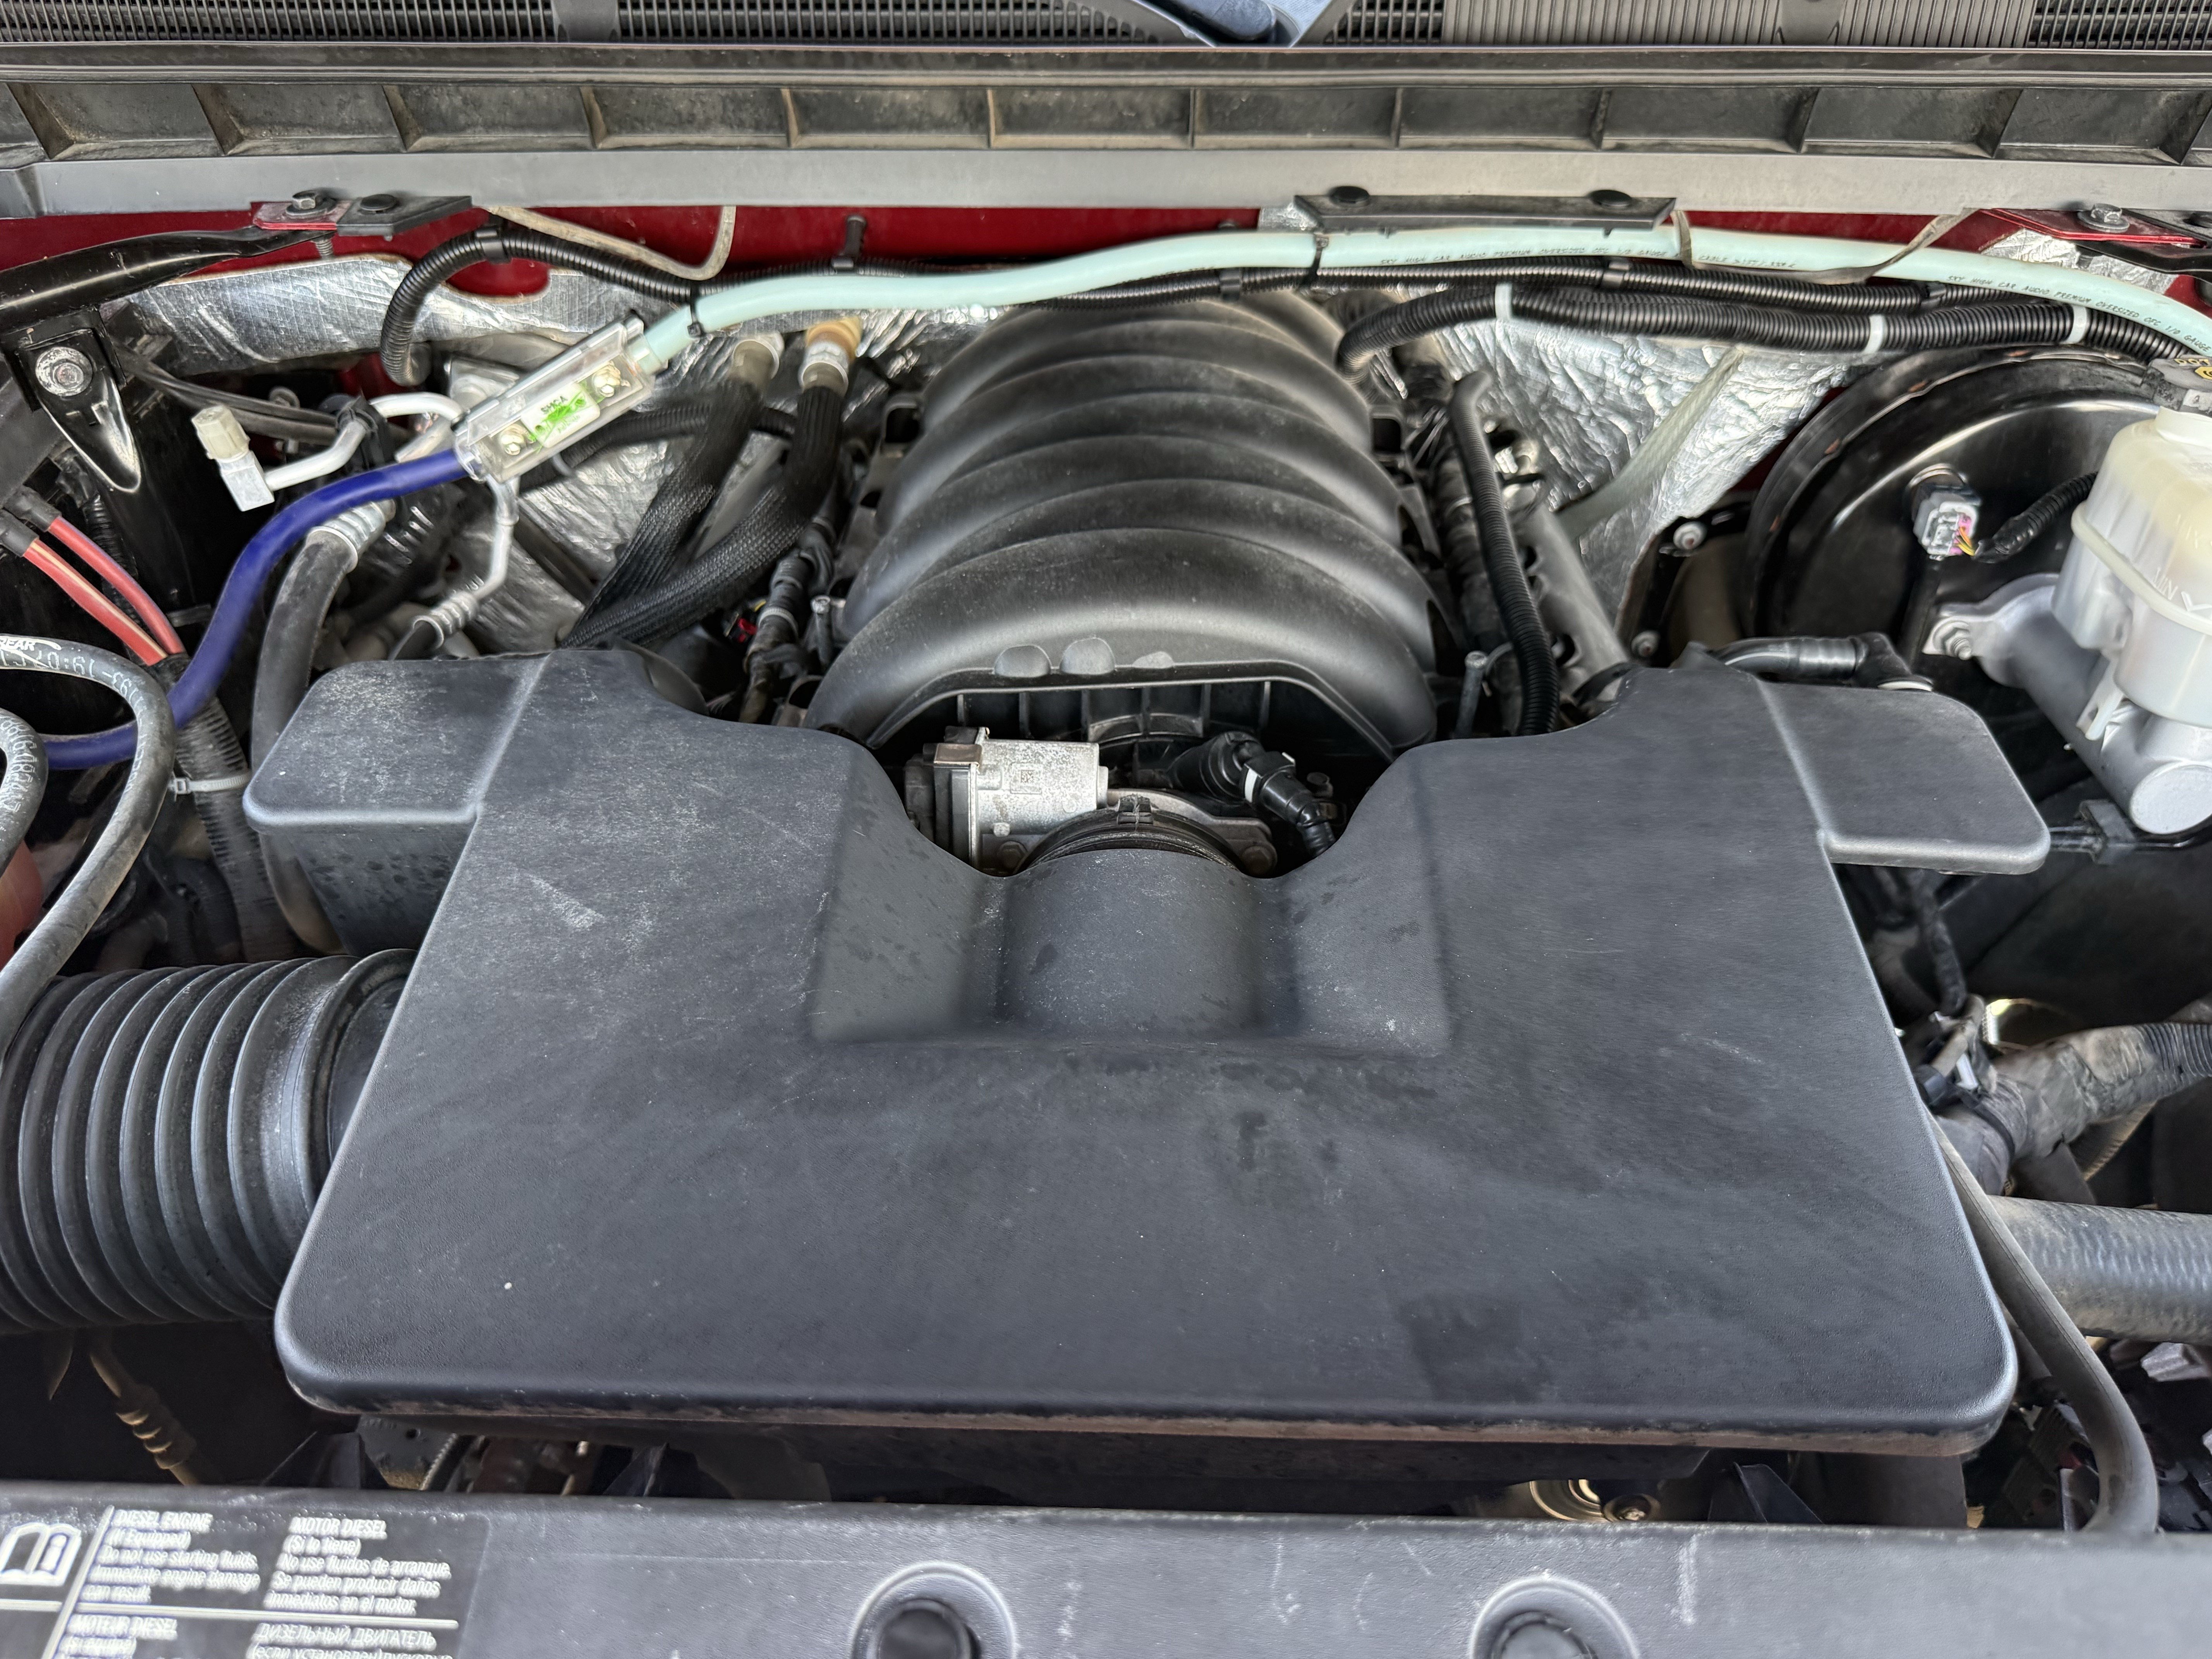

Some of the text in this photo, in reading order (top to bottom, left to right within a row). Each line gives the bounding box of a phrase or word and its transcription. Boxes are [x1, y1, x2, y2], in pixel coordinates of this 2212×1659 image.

[2021, 285, 2050, 294] AUDIO
[2054, 291, 2092, 304] PREMIUM
[2095, 301, 2140, 318] OVERSIZED
[2164, 325, 2181, 335] 1/0
[2183, 334, 2212, 352] GAUGE
[112, 1509, 213, 1532] DIESEL ENGINE
[289, 1517, 386, 1539] MOTOR DIESEL
[125, 1529, 191, 1549] Equipped)
[283, 1535, 305, 1554] (Si
[320, 1536, 361, 1556] tiene)
[96, 1546, 118, 1564] Do
[118, 1549, 143, 1565] not
[142, 1551, 168, 1567] use
[168, 1550, 219, 1570] starting
[276, 1553, 299, 1572] No
[299, 1557, 324, 1573] use
[325, 1555, 370, 1575] fluidos
[370, 1557, 389, 1576] de
[89, 1565, 260, 1594] Immediate engine damage
[271, 1571, 440, 1598] Se pueden producir daños
[263, 1590, 339, 1611] inmediatos
[339, 1596, 359, 1613] en
[359, 1595, 374, 1614] el
[129, 1617, 177, 1640] DIESEL
[251, 1623, 436, 1651] ДИЗЕЛЬНЫЙ ДВИГАТЕЛЬ
